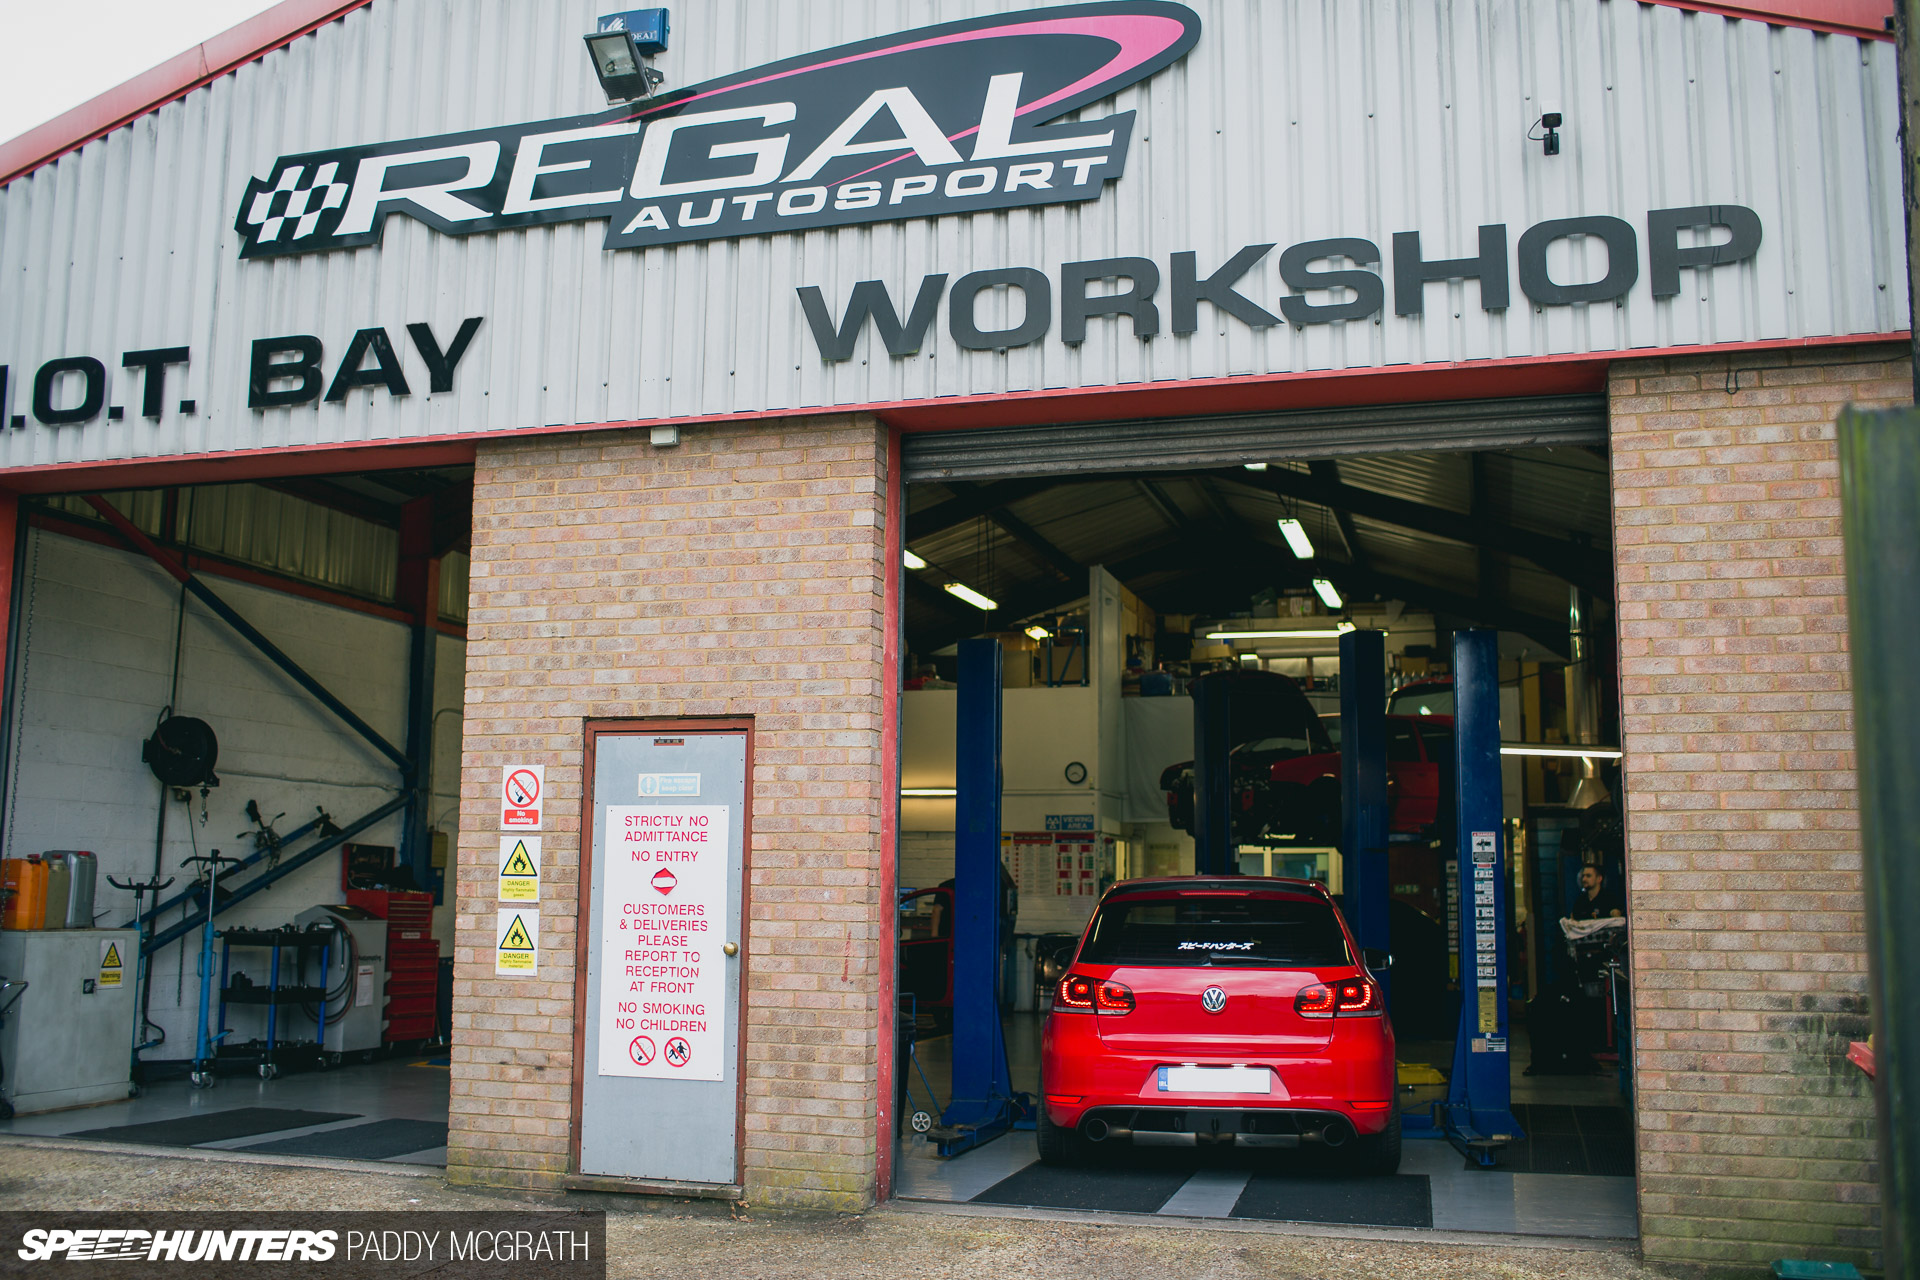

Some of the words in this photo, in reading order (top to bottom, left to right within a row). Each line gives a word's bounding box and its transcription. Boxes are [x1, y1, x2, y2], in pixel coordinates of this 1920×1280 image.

[332, 72, 1114, 236] REGAL
[621, 155, 1108, 235] AUTOSPORT
[797, 204, 1763, 361] WORKSHOP
[0, 345, 195, 430] .O.T.
[247, 316, 484, 409] BAY
[509, 817, 533, 825] smoking
[624, 815, 684, 827] STRICTLY
[689, 815, 709, 827] NO
[624, 830, 708, 842] ADMITTANCE
[631, 850, 651, 862] NO
[656, 850, 699, 862] ENTRY
[623, 903, 705, 916] CUSTOMERS
[619, 918, 628, 930] &
[633, 919, 708, 932] DELIVERIES
[638, 934, 688, 947] PLEASE
[625, 949, 677, 962] REPORT
[683, 951, 701, 963] TO
[625, 965, 700, 978] RECEPTION
[629, 980, 646, 992] AT
[650, 981, 695, 994] FRONT
[618, 1001, 638, 1013] NO
[642, 1002, 705, 1016] SMOKING
[616, 1018, 636, 1030] NO
[640, 1018, 707, 1032] CHILDREN
